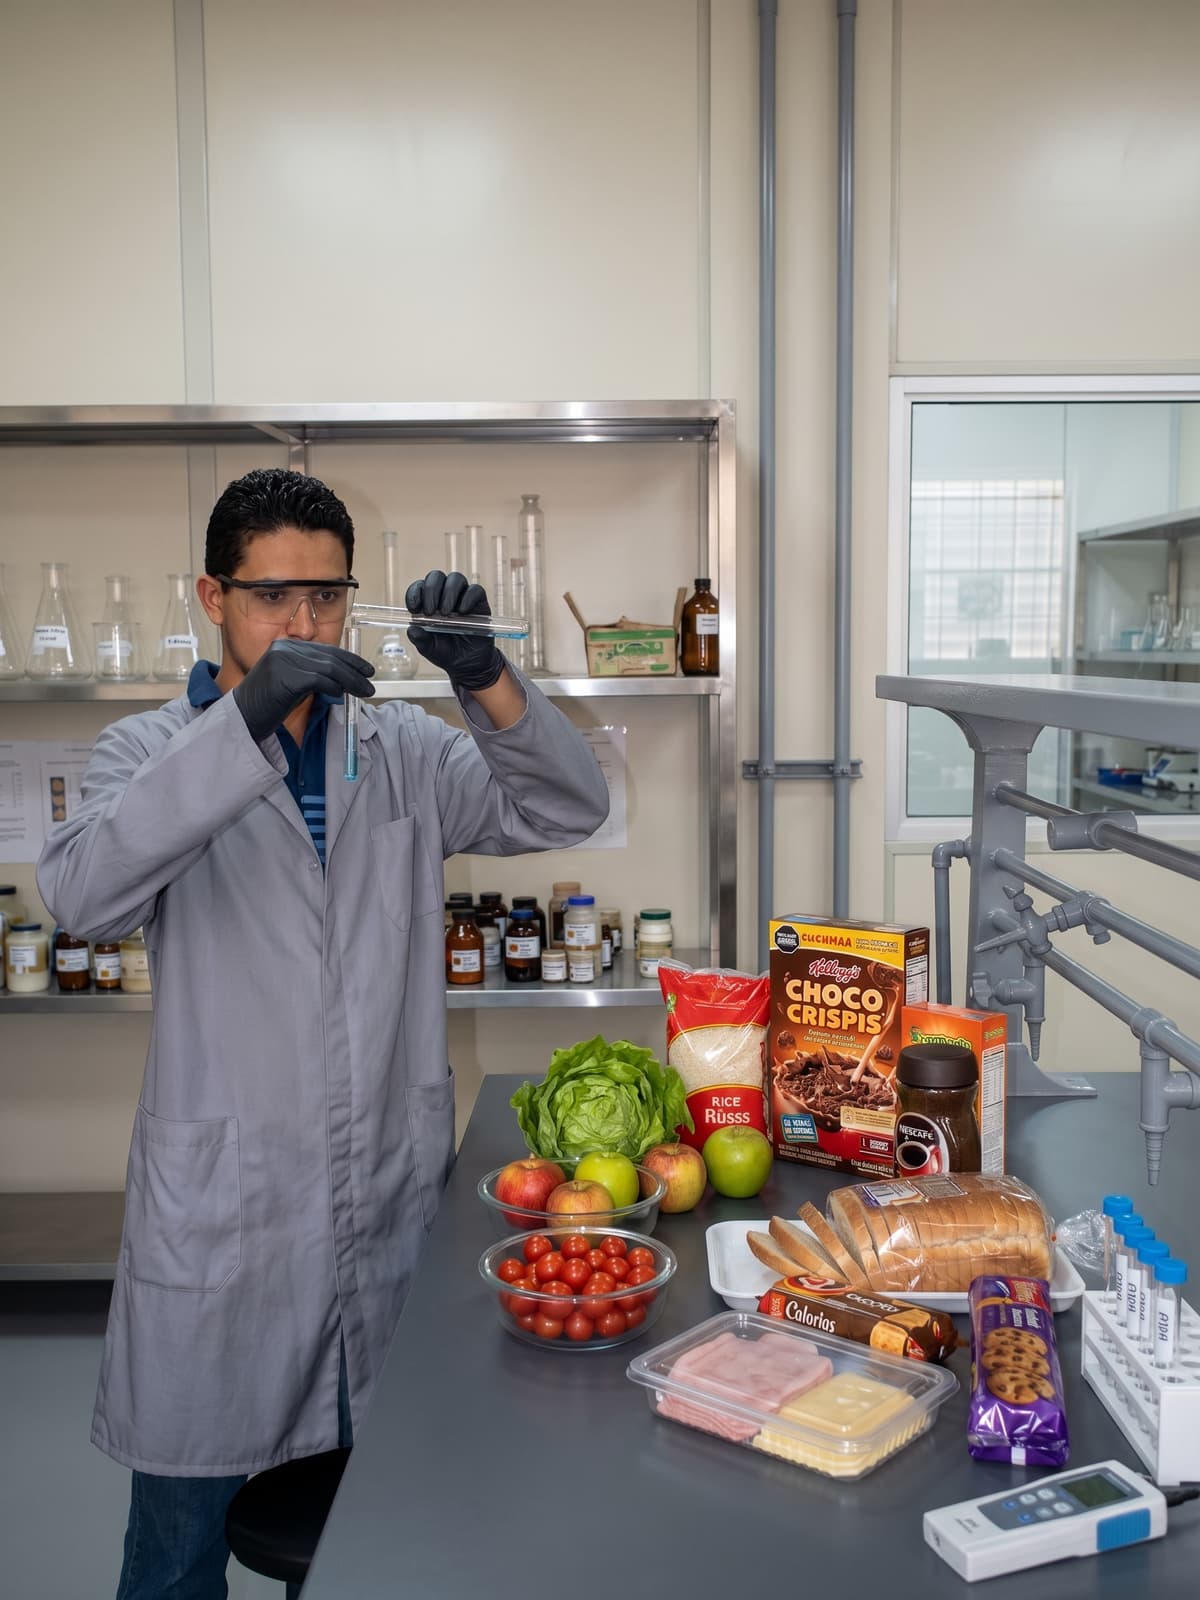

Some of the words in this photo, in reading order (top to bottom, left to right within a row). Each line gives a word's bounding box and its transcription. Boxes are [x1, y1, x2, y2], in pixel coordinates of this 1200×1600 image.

[809, 958, 861, 983] Kellogg's
[786, 979, 883, 1012] CHOCO
[786, 1003, 882, 1035] CRISPIS
[712, 1096, 741, 1107] RICE
[785, 1300, 836, 1334] Calorias
